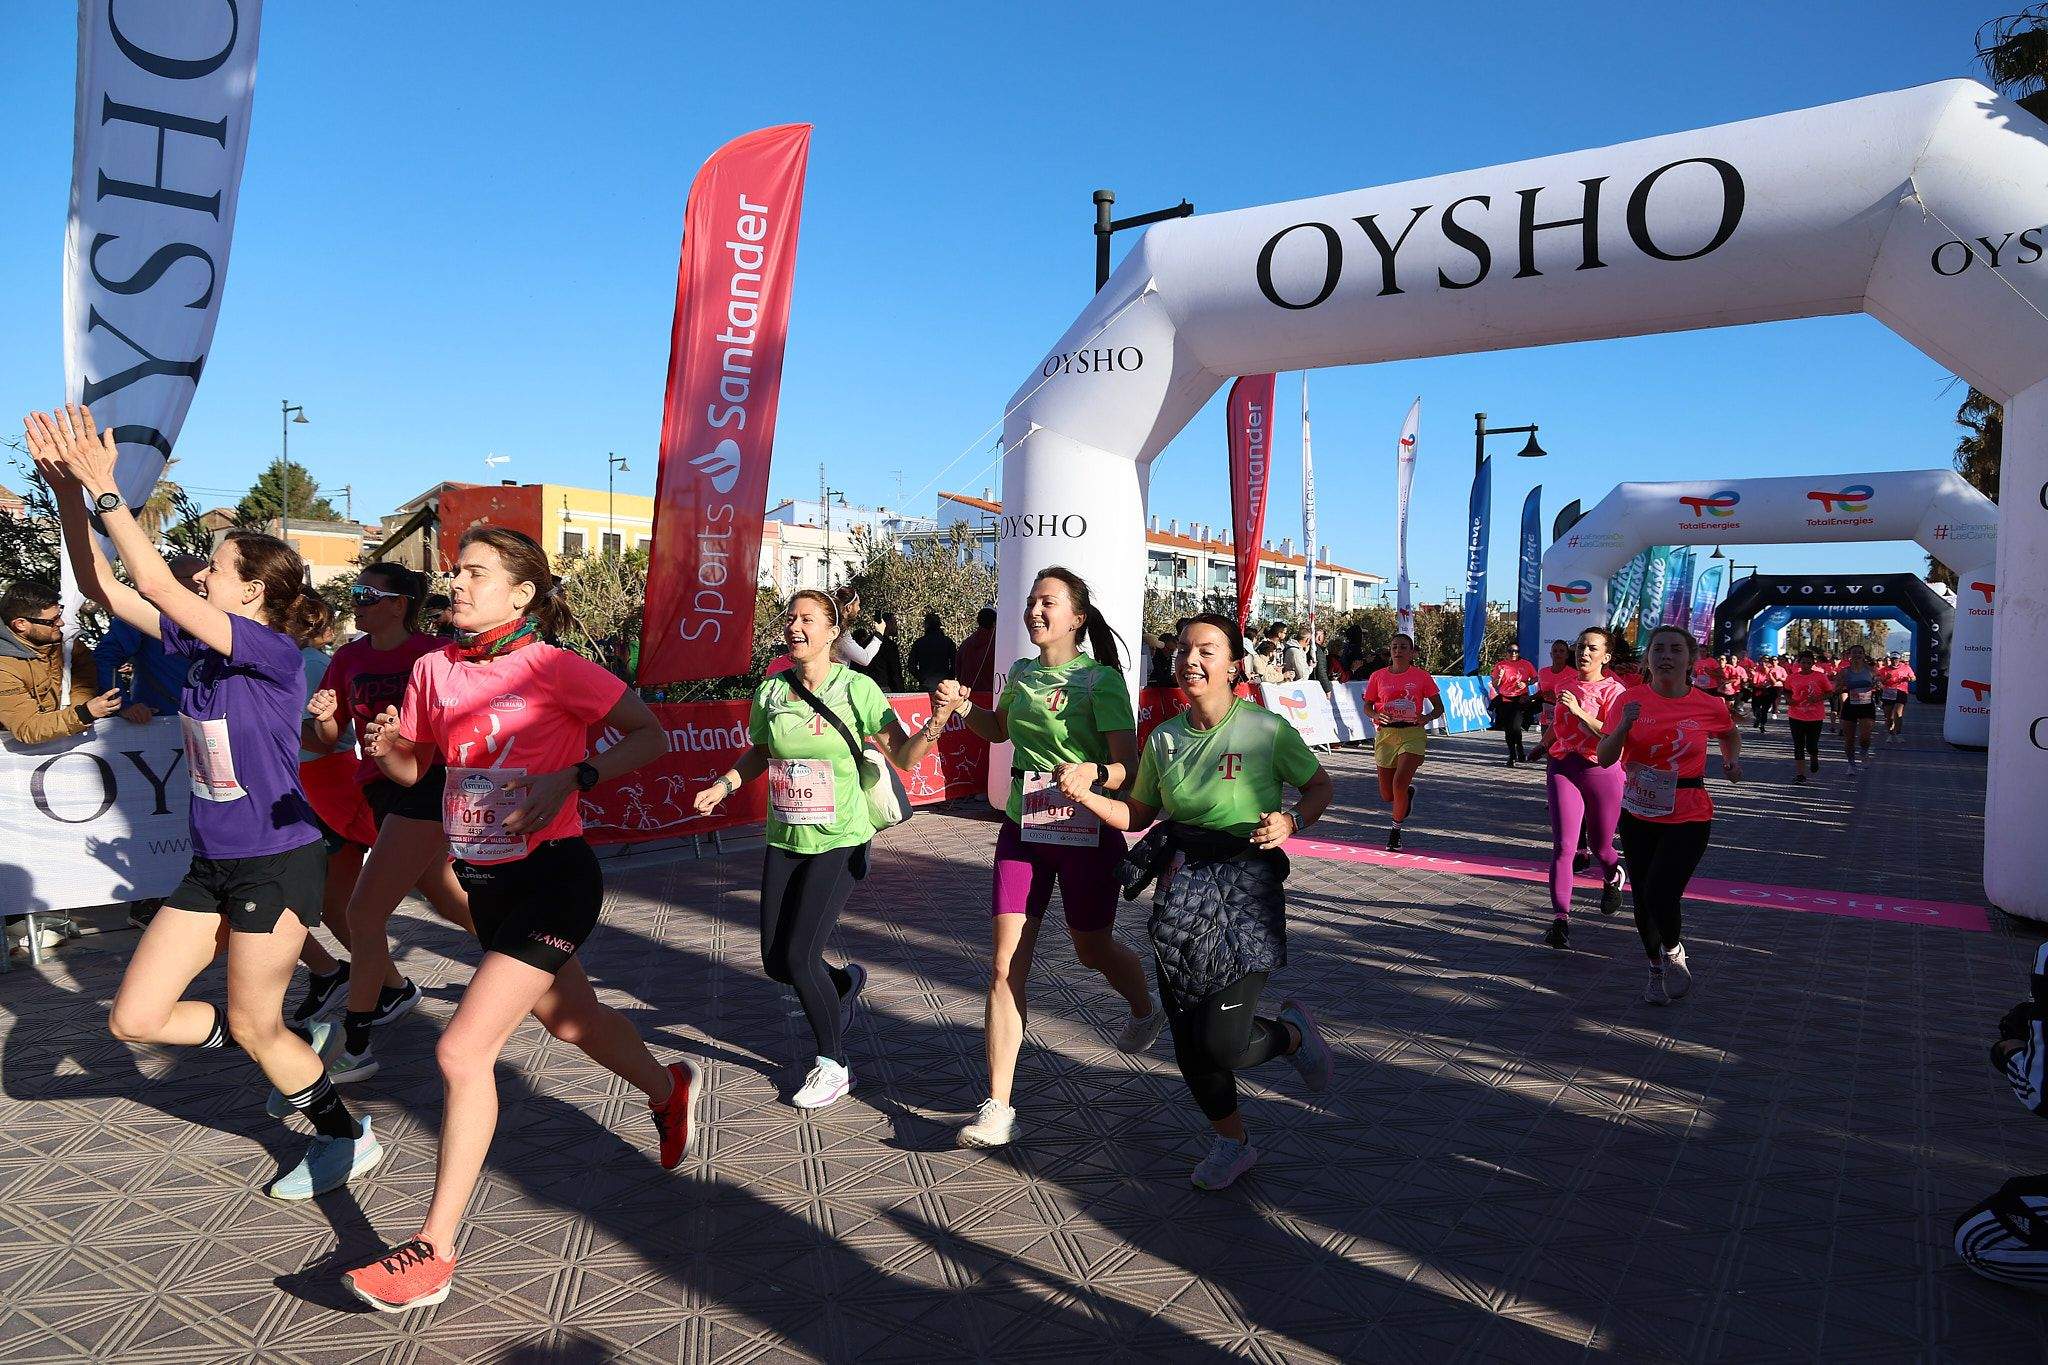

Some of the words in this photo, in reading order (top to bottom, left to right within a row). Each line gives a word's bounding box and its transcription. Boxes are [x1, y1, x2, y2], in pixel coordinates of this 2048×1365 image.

[1256, 157, 1745, 311] OYSHO
[1931, 228, 2043, 276] OYS
[707, 193, 769, 431] Santander
[1043, 346, 1144, 378] OYSHO
[1000, 514, 1088, 539] OYSHO
[1678, 520, 1740, 531] TotalEnergies
[1806, 515, 1873, 527] TotalEnergies
[680, 503, 734, 643] Sports
[1641, 557, 1665, 631] Batiste
[1776, 585, 1885, 594] VOLVO
[1545, 606, 1592, 615] TotalEnergies
[1968, 608, 1995, 616] TotalE
[1930, 621, 1940, 694] VOLVO
[788, 788, 813, 799] 016
[463, 809, 496, 824] 016
[1047, 804, 1076, 818] 016
[1729, 889, 1940, 915] OYSHO
